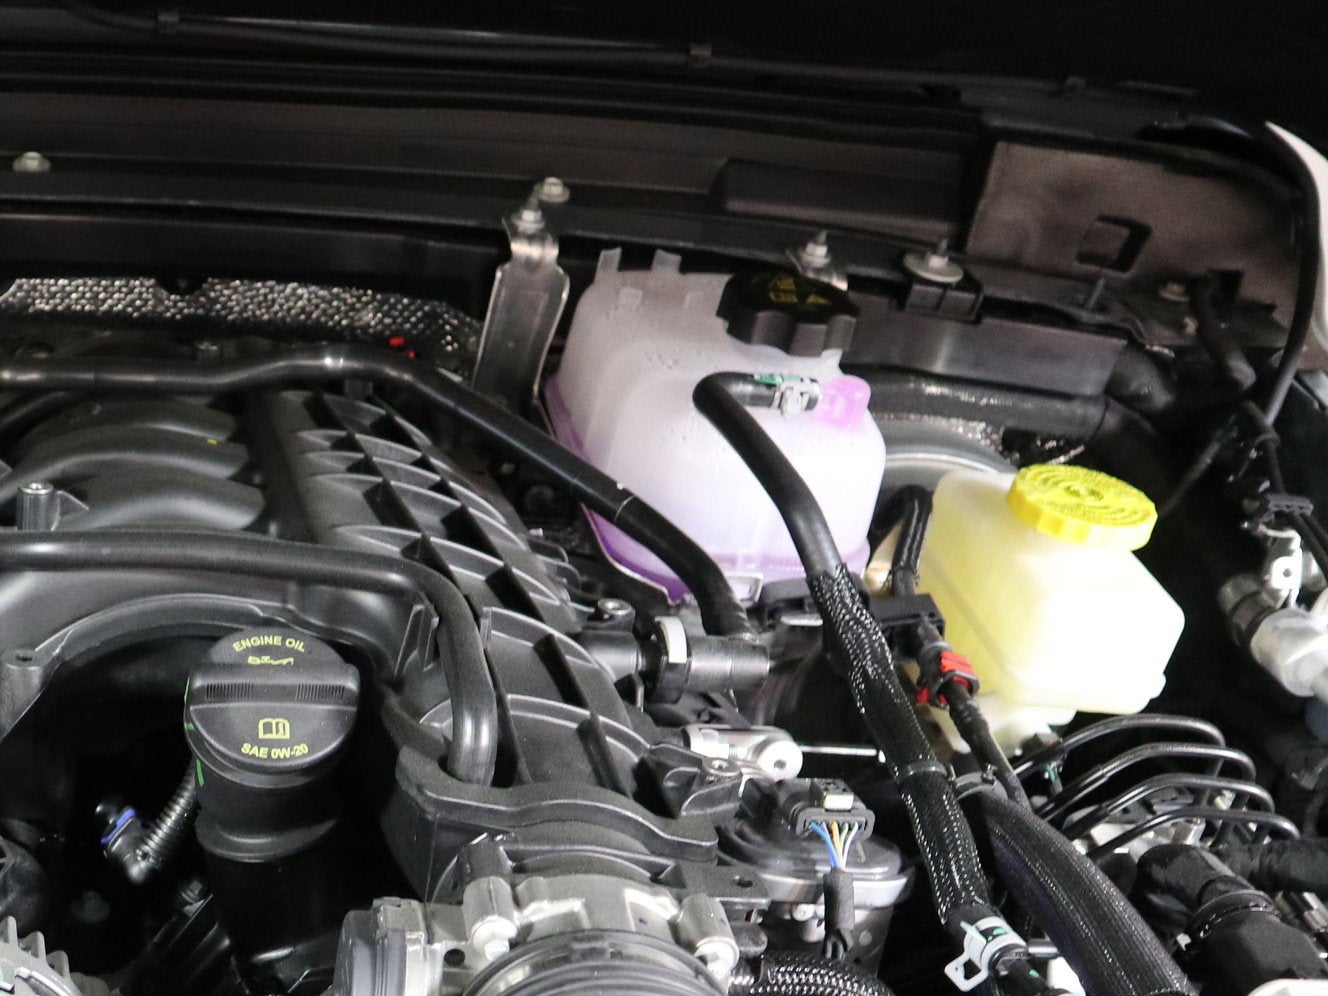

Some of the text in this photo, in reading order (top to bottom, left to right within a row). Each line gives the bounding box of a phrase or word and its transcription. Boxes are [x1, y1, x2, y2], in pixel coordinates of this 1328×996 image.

[232, 636, 306, 652] ENGINE OIL
[241, 743, 309, 759] SAE 0W-20
